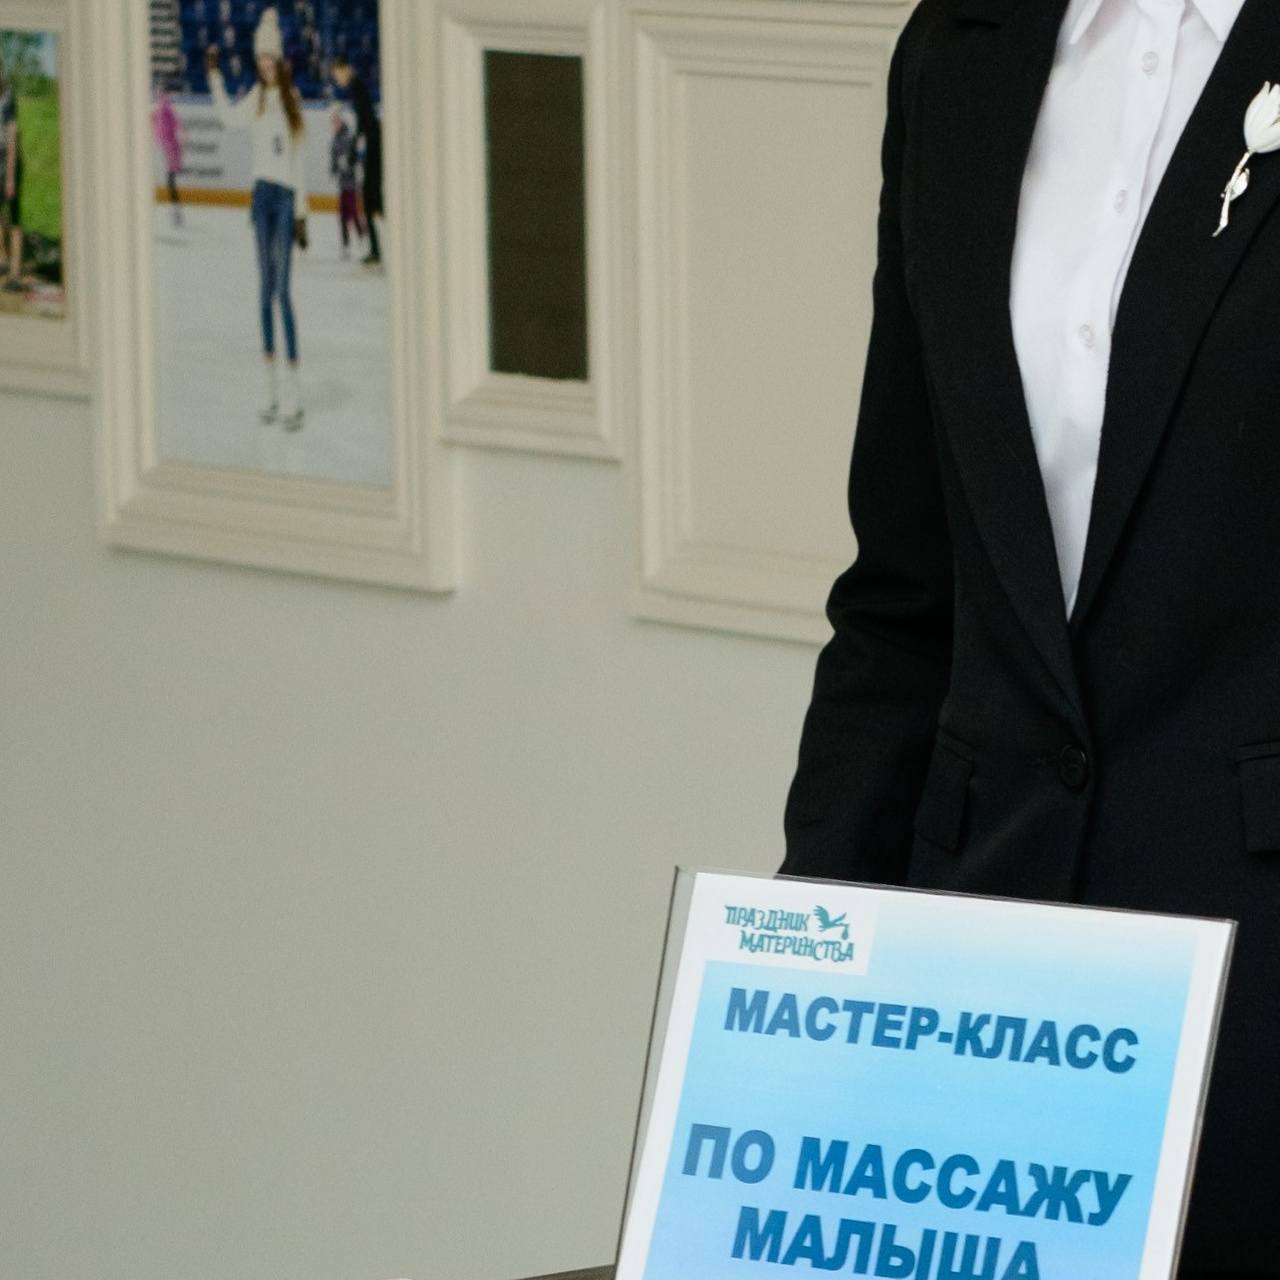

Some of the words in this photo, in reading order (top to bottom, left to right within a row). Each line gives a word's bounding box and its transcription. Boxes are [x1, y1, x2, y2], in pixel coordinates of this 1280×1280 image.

[725, 905, 811, 932] ПРАЗДНИК
[739, 930, 855, 962] МАТЕРИНСТВА
[724, 987, 1139, 1074] МАСТЕР-КЛАСС
[682, 1123, 776, 1184] ПО
[793, 1135, 1133, 1226] МАССАЖУ
